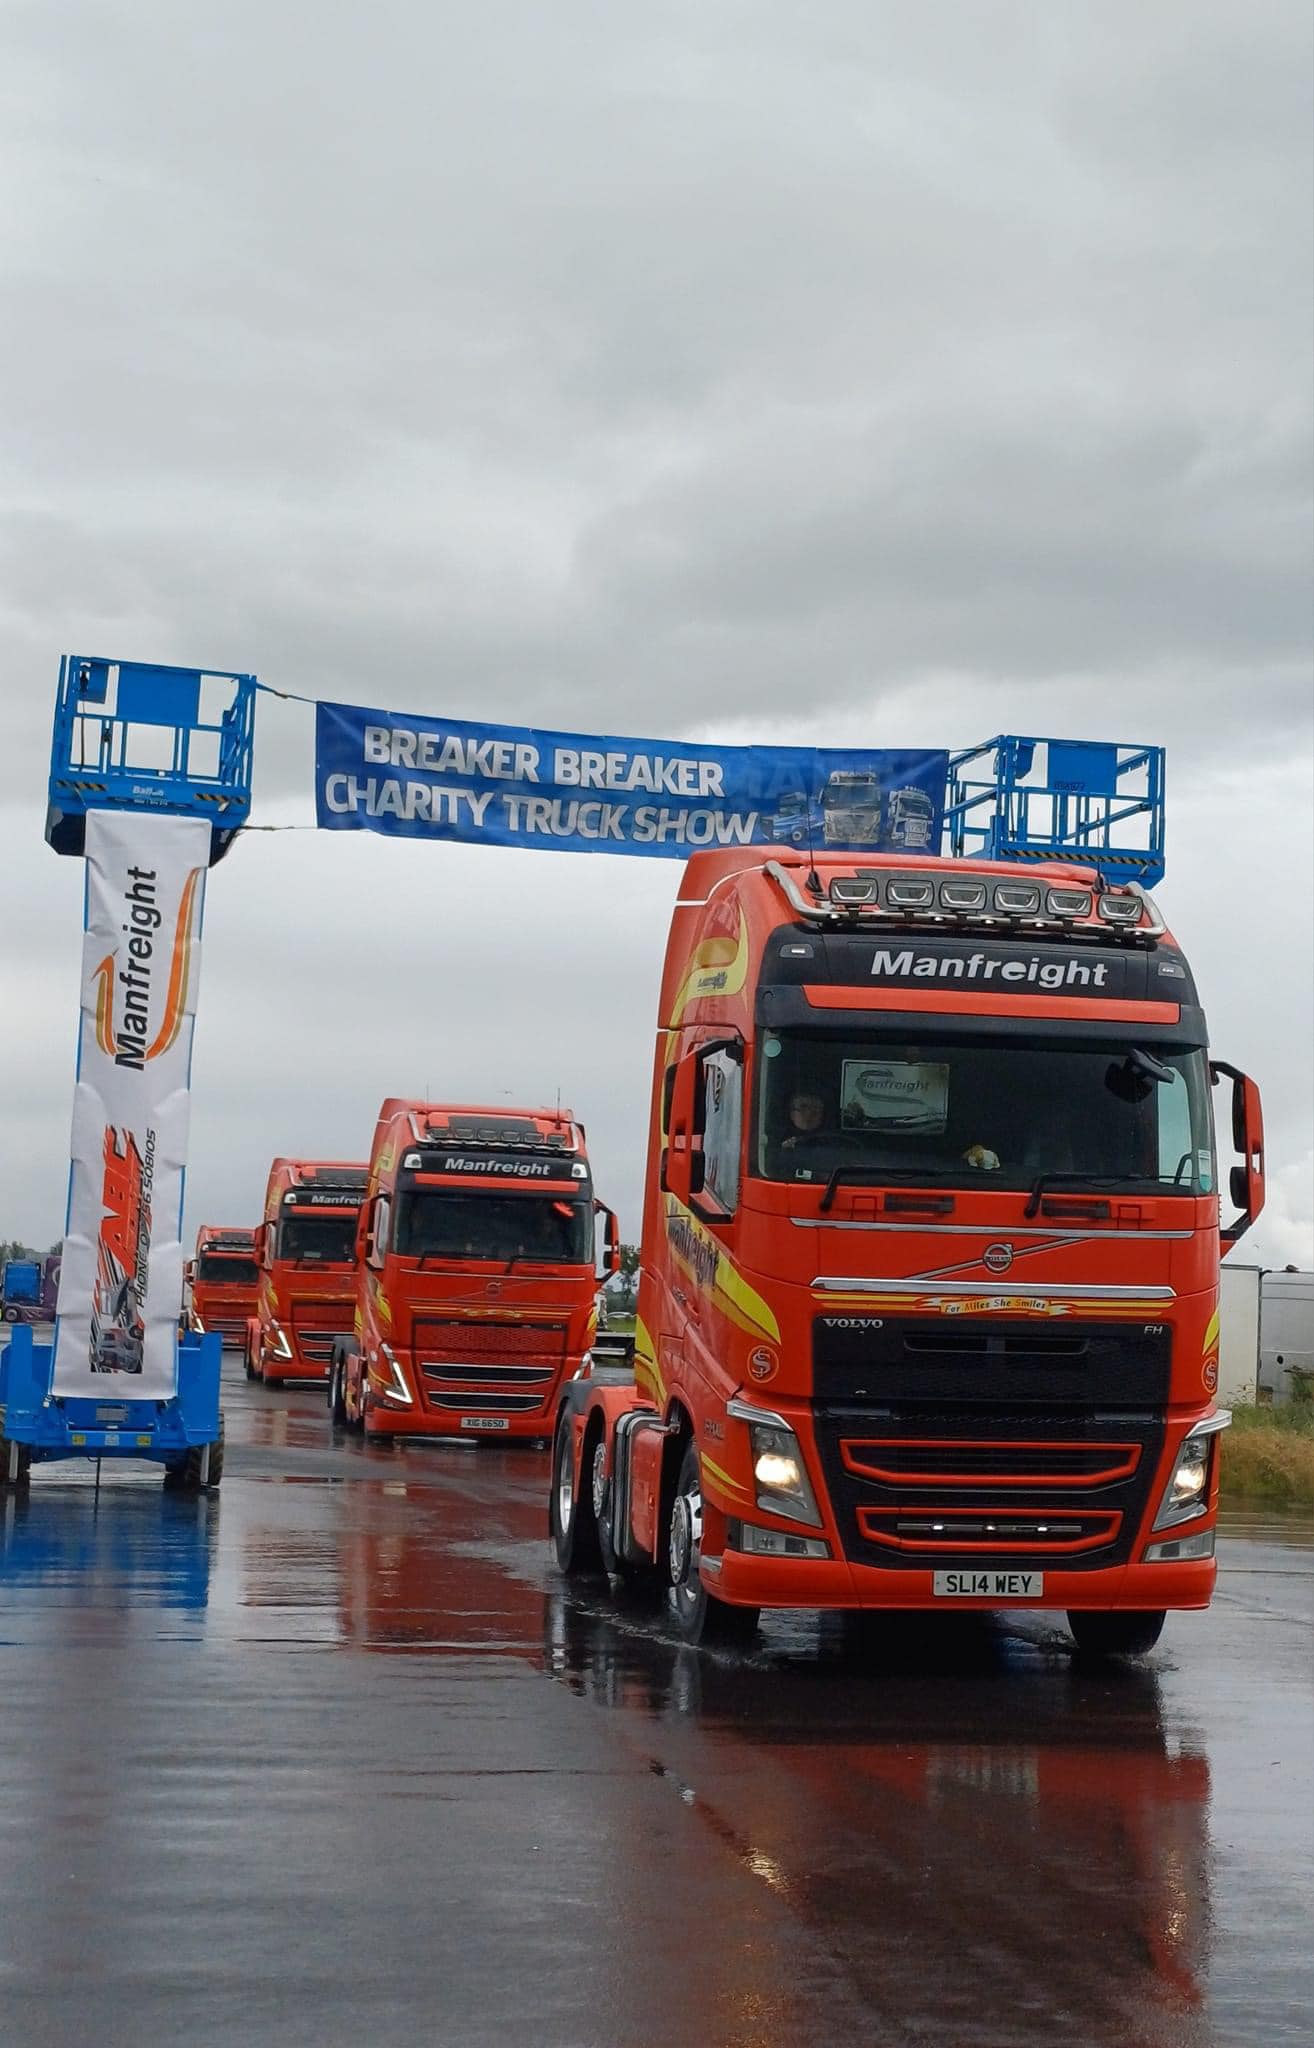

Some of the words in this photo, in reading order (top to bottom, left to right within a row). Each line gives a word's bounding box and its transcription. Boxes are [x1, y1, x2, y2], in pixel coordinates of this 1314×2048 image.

[364, 725, 540, 783] BREAKER
[554, 748, 725, 797] BREAKER
[325, 772, 495, 827] CHARITY
[503, 793, 629, 841] TRUCK
[632, 805, 759, 845] SHOW
[115, 866, 162, 1071] Manfreight
[870, 950, 1108, 989] Manfreight
[444, 1158, 551, 1176] Manfreight
[101, 1123, 144, 1279] ABC
[311, 1195, 366, 1206] Manfrei
[944, 1304, 960, 1313] For
[993, 1298, 1011, 1307] She
[1014, 1298, 1045, 1310] Smiles
[822, 1318, 884, 1329] VOLVO
[1143, 1325, 1163, 1335] FH
[946, 1574, 989, 1593] SL14
[995, 1575, 1032, 1593] WEY
